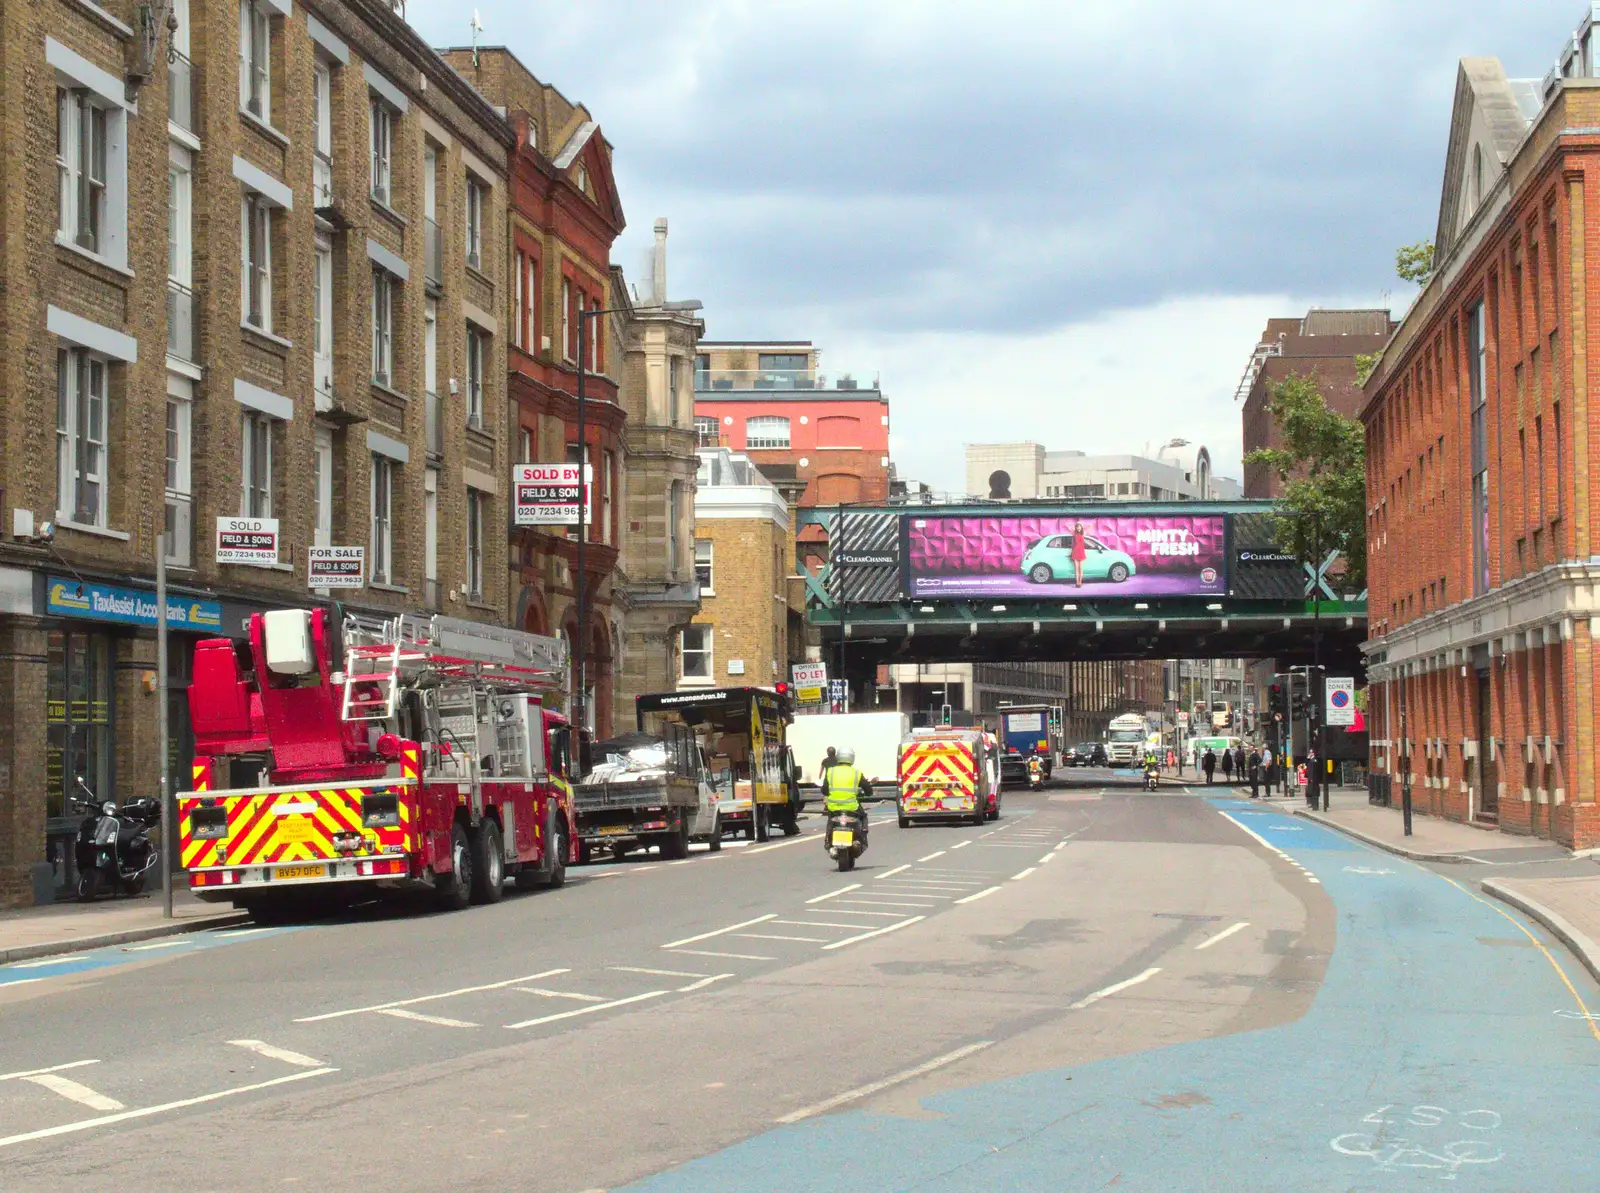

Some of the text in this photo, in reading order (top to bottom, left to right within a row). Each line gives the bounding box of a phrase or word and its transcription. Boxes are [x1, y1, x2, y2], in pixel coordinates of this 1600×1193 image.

[524, 469, 580, 480] SOLD BY
[521, 488, 579, 498] FIELD & SON
[518, 507, 536, 516] 020
[539, 507, 562, 516] 7234
[230, 521, 262, 531] SOLD
[222, 534, 242, 543] FIELD
[252, 536, 272, 544] SONS
[1137, 529, 1188, 542] MINTY
[310, 549, 363, 558] FOR SALE
[1151, 542, 1199, 556] FRESH
[341, 563, 359, 571] SONS
[92, 592, 135, 616] TaxAssist
[135, 599, 186, 622] Accotants
[795, 670, 824, 680] TO LET
[279, 867, 301, 877] BV57
